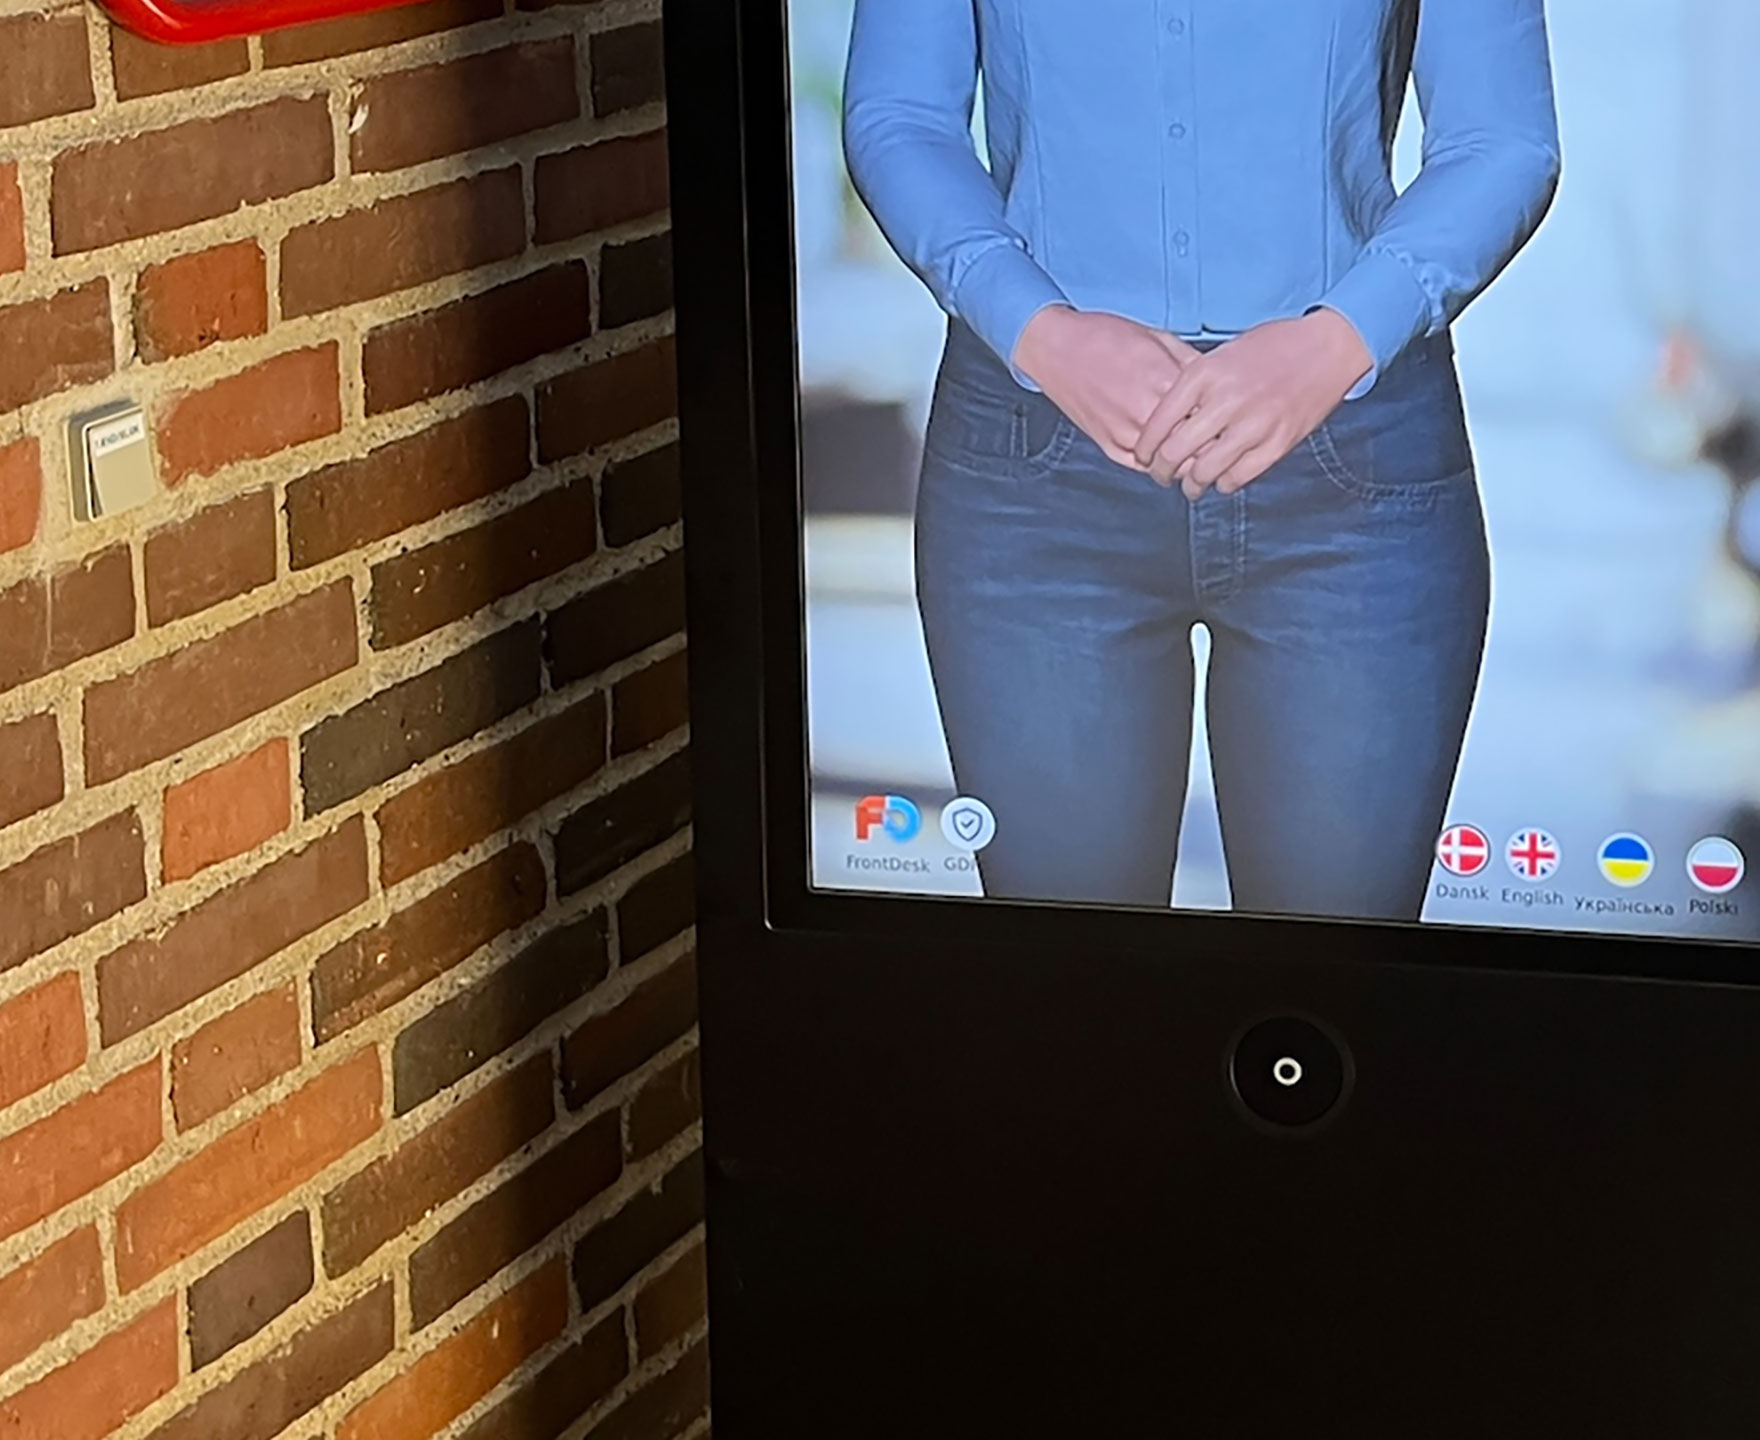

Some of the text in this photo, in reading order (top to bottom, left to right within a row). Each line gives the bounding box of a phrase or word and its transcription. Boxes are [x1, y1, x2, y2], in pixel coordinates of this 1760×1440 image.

[847, 855, 931, 873] FrontDesk
[1436, 883, 1490, 901] Dansk
[1502, 889, 1564, 906] English
[1574, 897, 1675, 917] Українська
[1689, 899, 1739, 916] Polski
